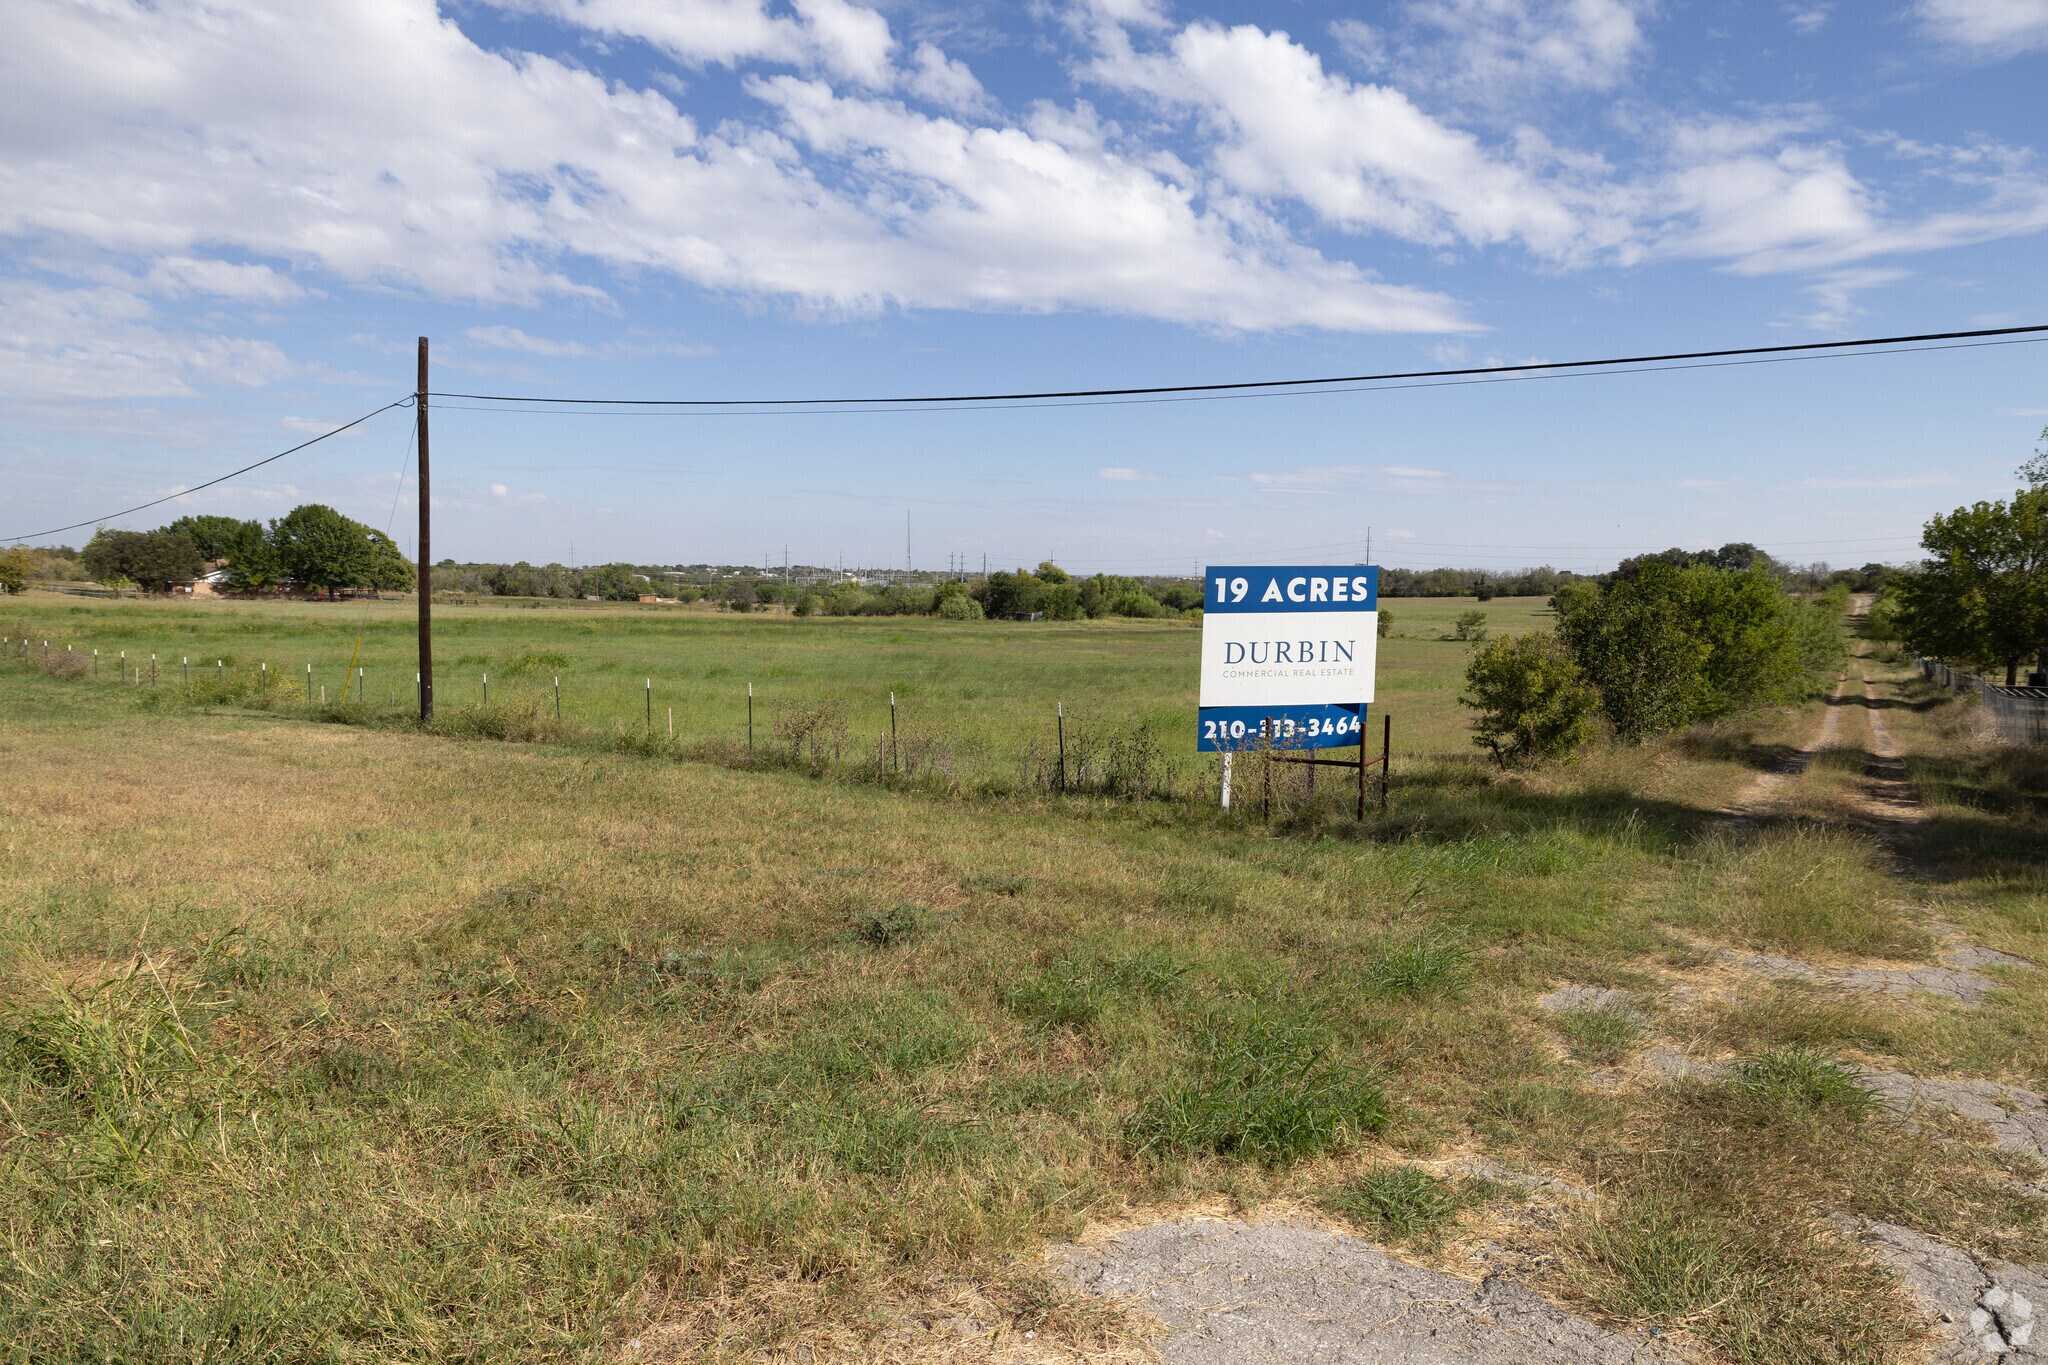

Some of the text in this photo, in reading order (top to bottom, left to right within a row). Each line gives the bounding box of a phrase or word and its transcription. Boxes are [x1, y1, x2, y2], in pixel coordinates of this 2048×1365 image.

[1215, 576, 1368, 603] 19 ACRES
[1224, 640, 1356, 664] DURBIN
[1222, 668, 1354, 679] COMMERCIAL REAL ESTATE
